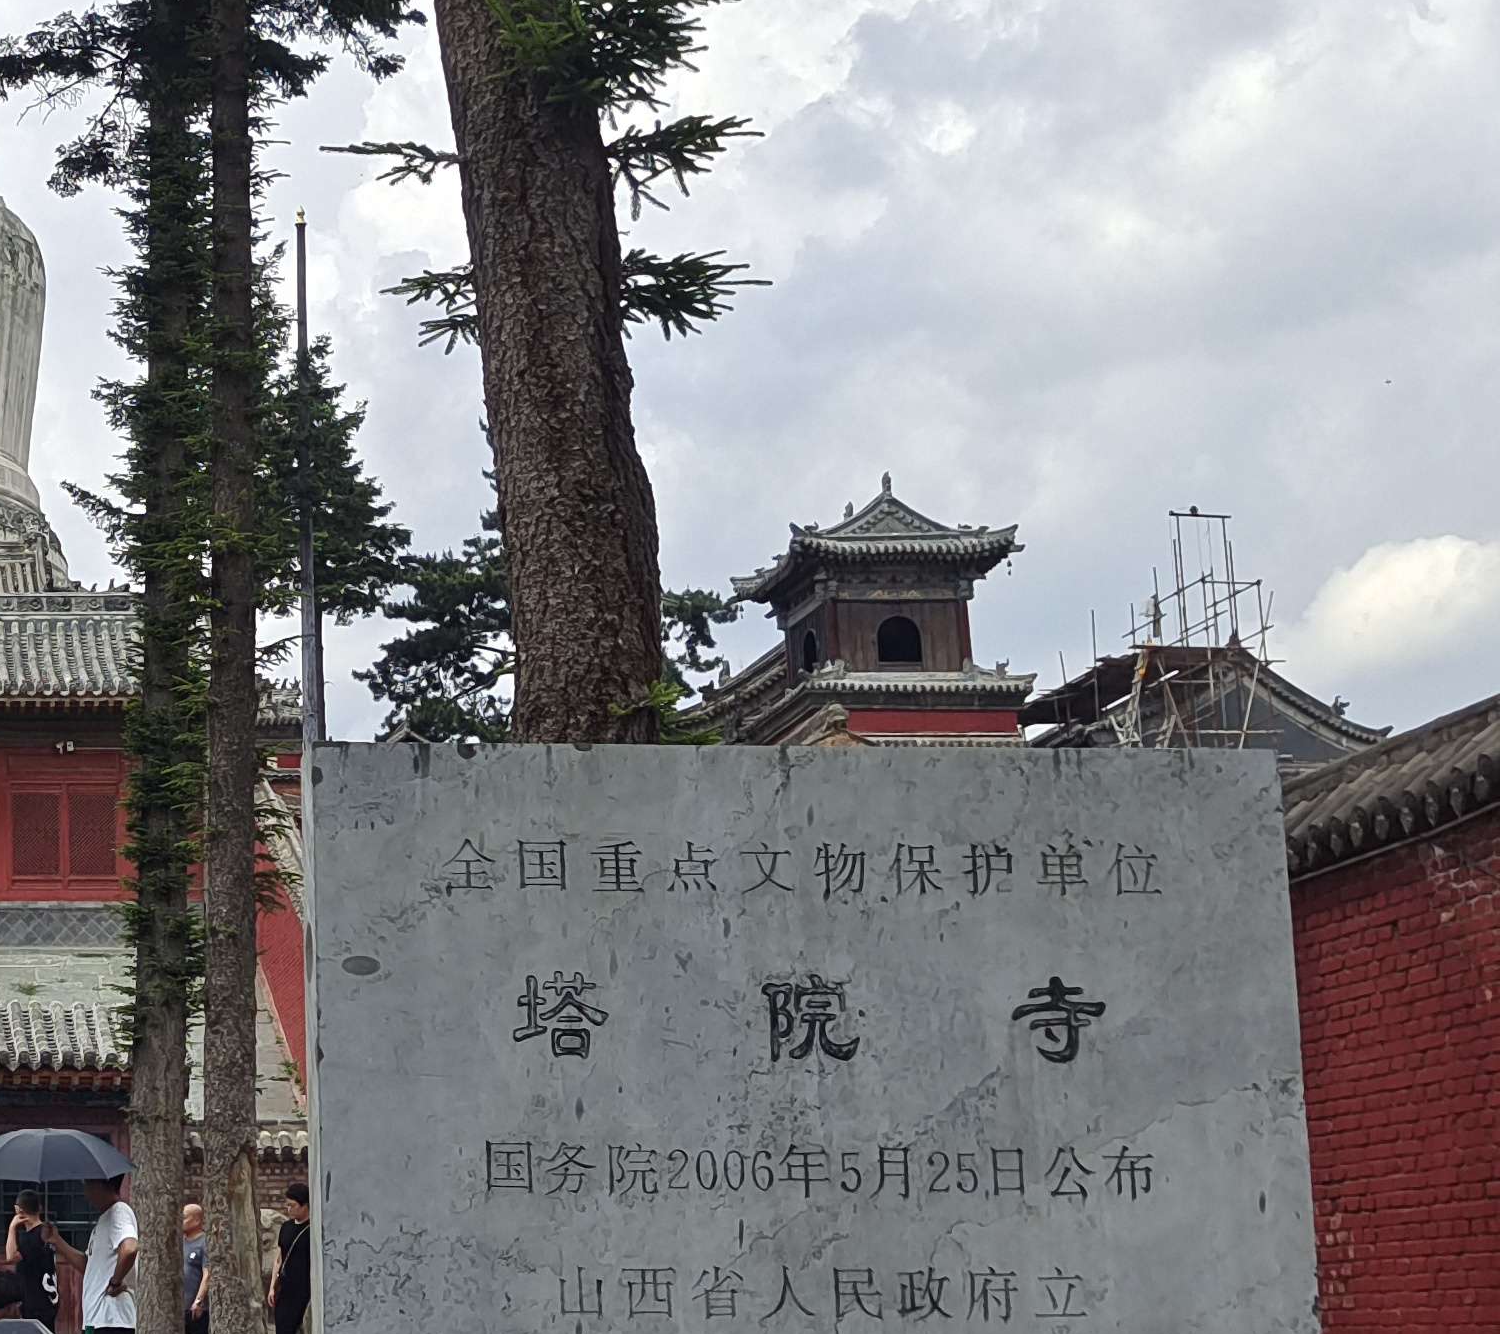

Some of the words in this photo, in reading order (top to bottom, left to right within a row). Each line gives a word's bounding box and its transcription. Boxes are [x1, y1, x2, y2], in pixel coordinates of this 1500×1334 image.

[444, 837, 1164, 899] 全国重点文物保护单位
[512, 970, 1107, 1063] 塔院寺
[484, 1139, 1155, 1201] 国务院2006年5月25日公布
[559, 1265, 1090, 1323] 山西省人民政府立
